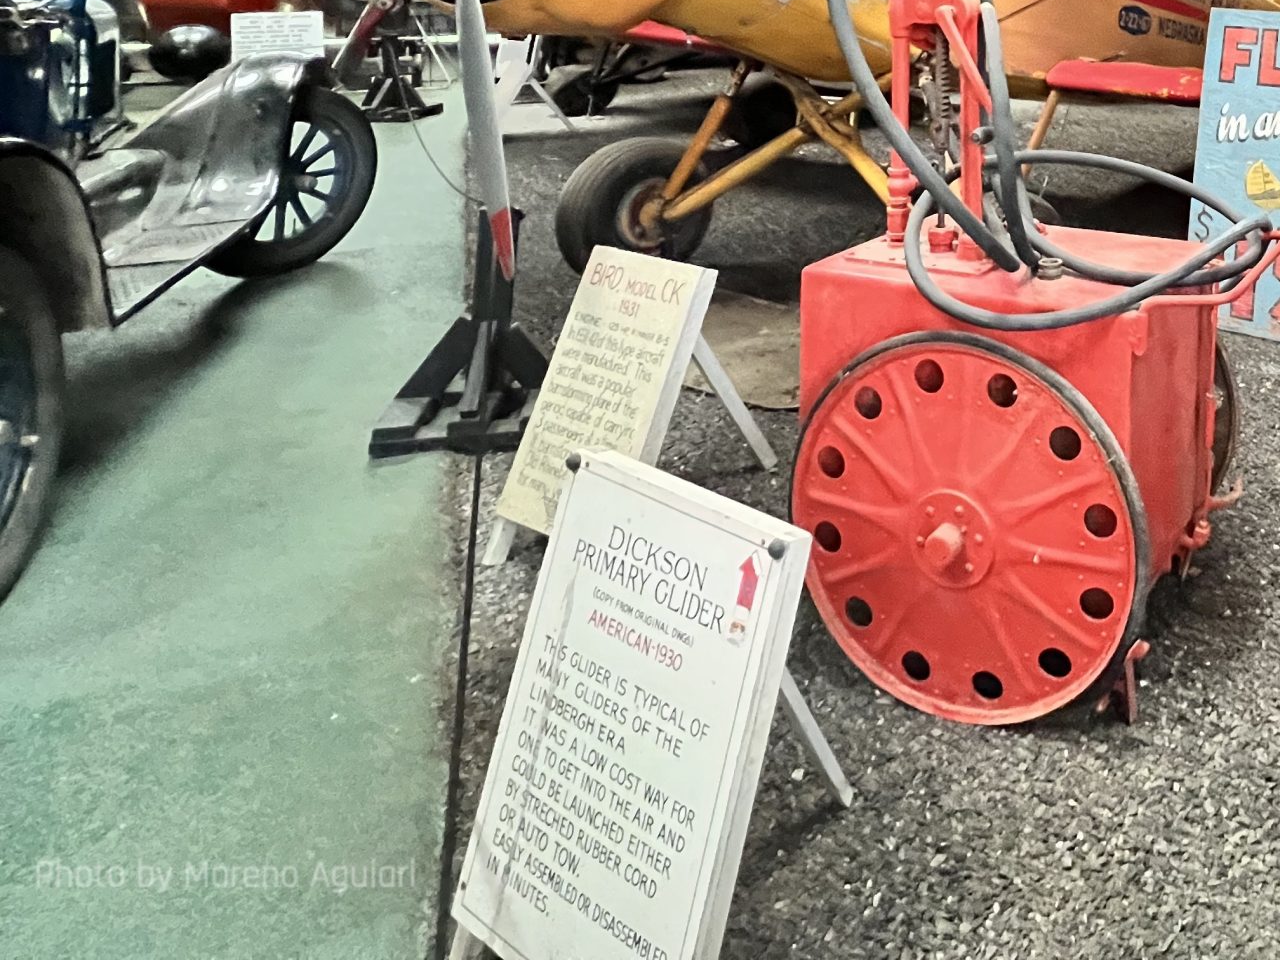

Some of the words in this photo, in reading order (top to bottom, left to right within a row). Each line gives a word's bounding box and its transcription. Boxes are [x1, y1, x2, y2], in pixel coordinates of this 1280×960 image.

[1217, 102, 1249, 142] in
[618, 299, 640, 318] 1931
[624, 278, 657, 301] MODEL
[661, 278, 687, 305] CK
[572, 539, 652, 596] PRIMARY
[654, 579, 725, 634] GLIDER
[608, 525, 708, 591] DICKSON
[587, 609, 683, 671] AMERICAN-1930
[593, 586, 614, 606] (COPY
[616, 597, 634, 616] FROM
[635, 609, 669, 636] ORIGINAL
[529, 682, 596, 735] LINDBERGH
[599, 724, 625, 755] ERA
[536, 658, 570, 690] MANY
[575, 682, 629, 725] GLIDERS
[632, 716, 651, 737] OF
[655, 726, 683, 758] THE
[544, 635, 568, 661] THIS
[570, 652, 612, 688] GLIDER
[615, 676, 628, 696] IS
[634, 685, 686, 731] TYPICAL
[690, 719, 710, 742] OF
[518, 730, 540, 760] ONE
[544, 746, 557, 769] TO
[558, 758, 581, 783] GET
[580, 772, 606, 802] INTO
[609, 790, 633, 821] THE
[632, 808, 655, 833] AIR
[657, 824, 685, 853] AND
[522, 705, 536, 726] IT
[541, 716, 567, 746] WAS
[569, 737, 578, 756] A
[581, 743, 608, 774] LOW
[609, 763, 642, 795] COST
[644, 782, 669, 813] WAY
[671, 800, 696, 832] FOR
[499, 803, 516, 830] OR
[518, 817, 549, 852] AUTO
[553, 841, 580, 878] TOW.
[504, 778, 520, 801] BY
[520, 789, 575, 841] STRECHED
[576, 828, 621, 877] RUBBER
[624, 863, 657, 899] CORD
[512, 755, 546, 790] COULD
[547, 779, 563, 803] BE
[563, 790, 625, 844] LAUNCHED
[627, 834, 672, 880] EITHER
[486, 852, 500, 877] IN
[524, 852, 577, 906] ASSEMBLED
[577, 890, 590, 918] OR
